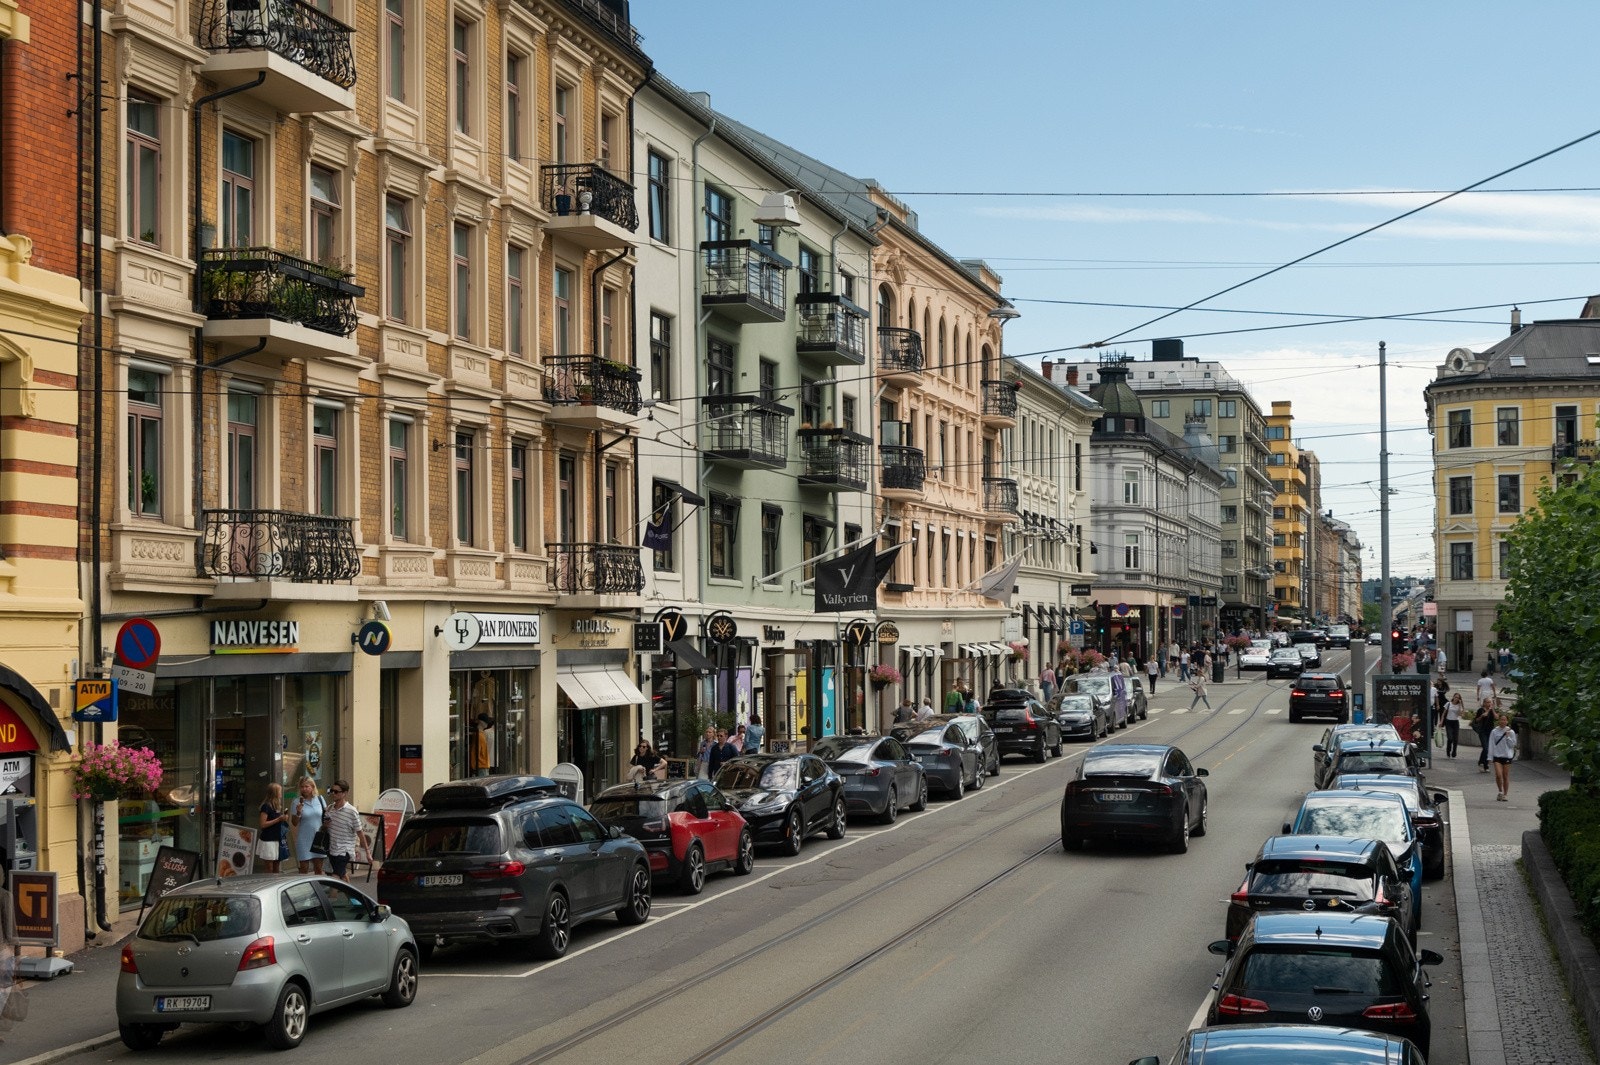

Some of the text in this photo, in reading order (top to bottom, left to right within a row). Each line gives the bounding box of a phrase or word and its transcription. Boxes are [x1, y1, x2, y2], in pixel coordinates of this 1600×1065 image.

[822, 593, 868, 606] Valkyrien
[214, 620, 299, 646] NARVESEN
[498, 620, 538, 638] PIONEERS
[1073, 622, 1081, 634] P
[121, 669, 130, 677] 07
[136, 672, 145, 680] 20
[80, 683, 107, 694] ATM
[3, 760, 20, 773] ATM
[163, 861, 187, 872] SLUSH
[425, 875, 462, 885] BU 26579
[167, 997, 208, 1008] RK 19704
